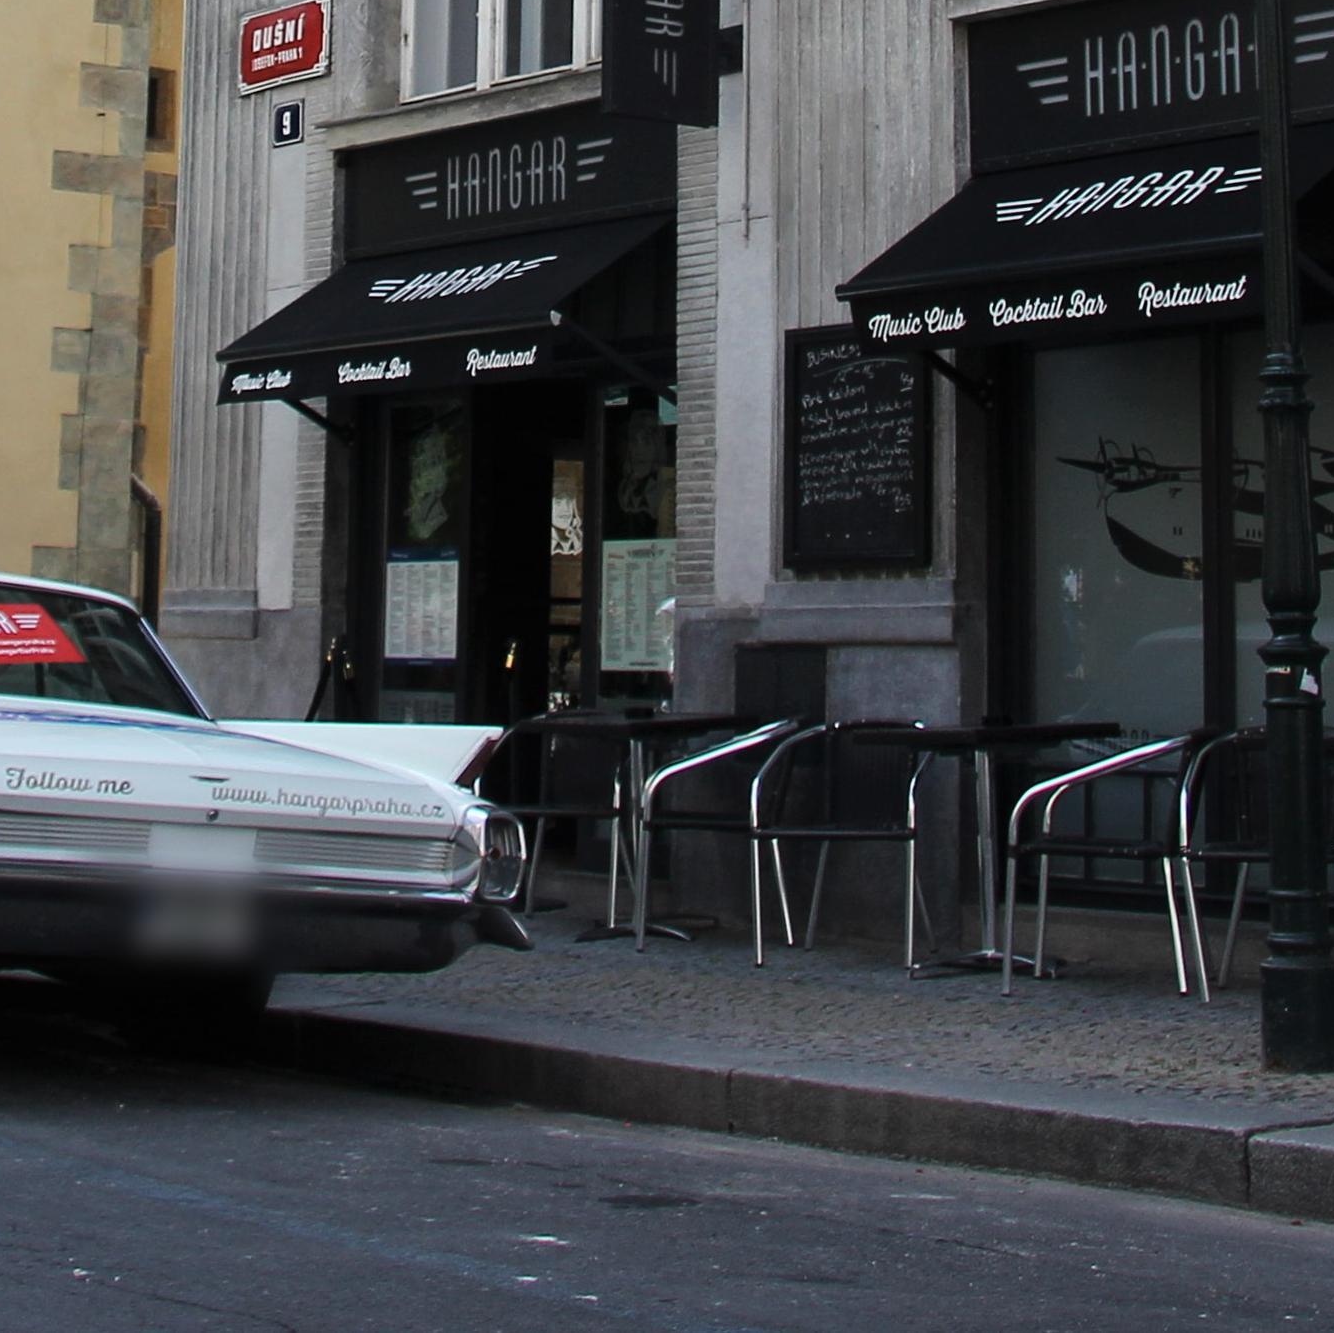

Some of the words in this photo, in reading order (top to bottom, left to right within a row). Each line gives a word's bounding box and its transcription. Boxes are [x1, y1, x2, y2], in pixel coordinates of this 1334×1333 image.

[252, 13, 306, 53] DUŠNÍ
[1085, 13, 1260, 117] HANGA
[282, 111, 292, 135] 9
[446, 136, 566, 220] HANGAR
[1025, 166, 1225, 226] HANGAR
[384, 260, 520, 304] HANGAR
[868, 314, 923, 343] Music
[924, 307, 966, 334] Club
[989, 294, 1064, 327] Cocktail
[1065, 289, 1108, 319] Bar
[1138, 275, 1247, 317] Restaurant
[231, 372, 265, 395] Music
[338, 361, 387, 384] Cocktail
[385, 357, 411, 379] Bar
[466, 346, 537, 376] Restaurant
[5, 767, 92, 792] Follow
[96, 778, 135, 795] me
[212, 787, 445, 817] www.hangarpraha.cz
